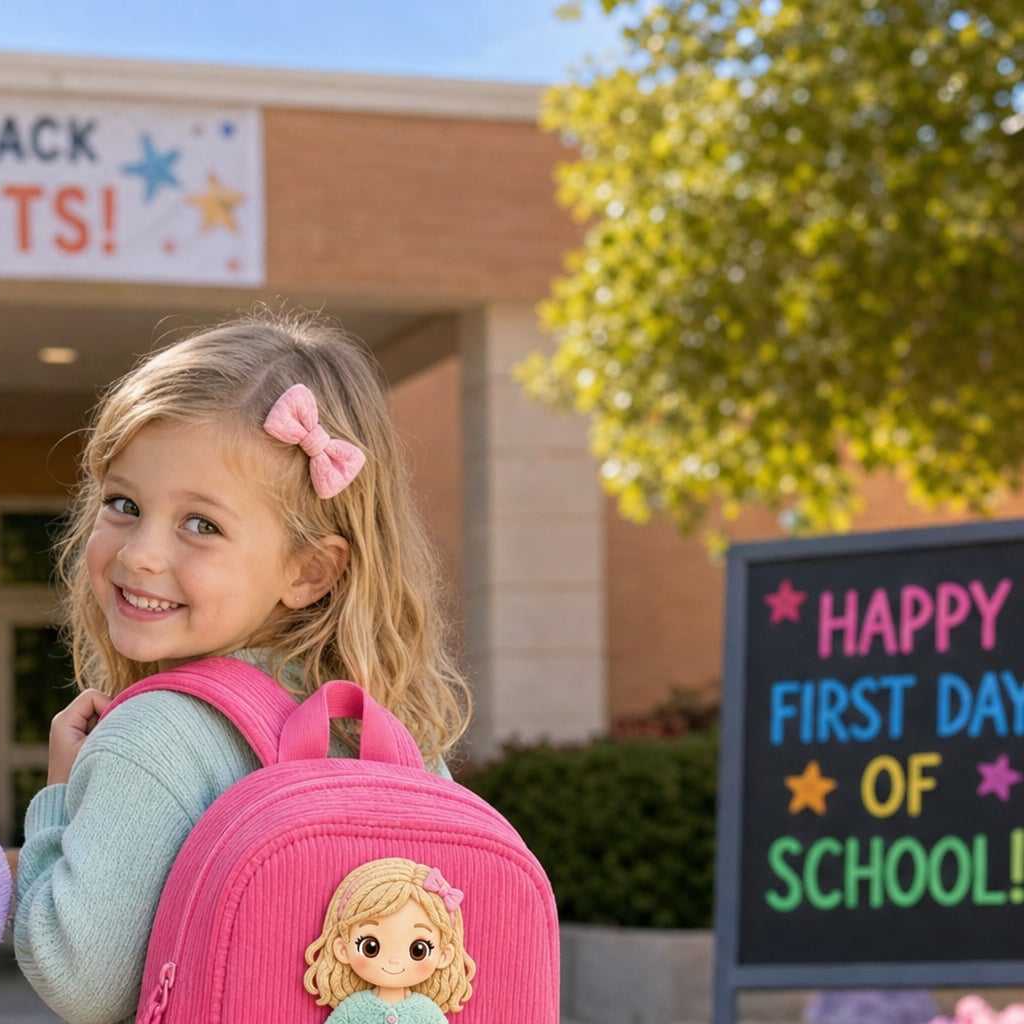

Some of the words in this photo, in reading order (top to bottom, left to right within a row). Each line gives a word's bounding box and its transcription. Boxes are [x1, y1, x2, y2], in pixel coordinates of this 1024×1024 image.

[819, 579, 1012, 657] HAPPY
[771, 674, 916, 742] FIRST
[937, 671, 1024, 738] DAY
[861, 753, 942, 817] OF
[766, 828, 1024, 910] SCHOOL!
